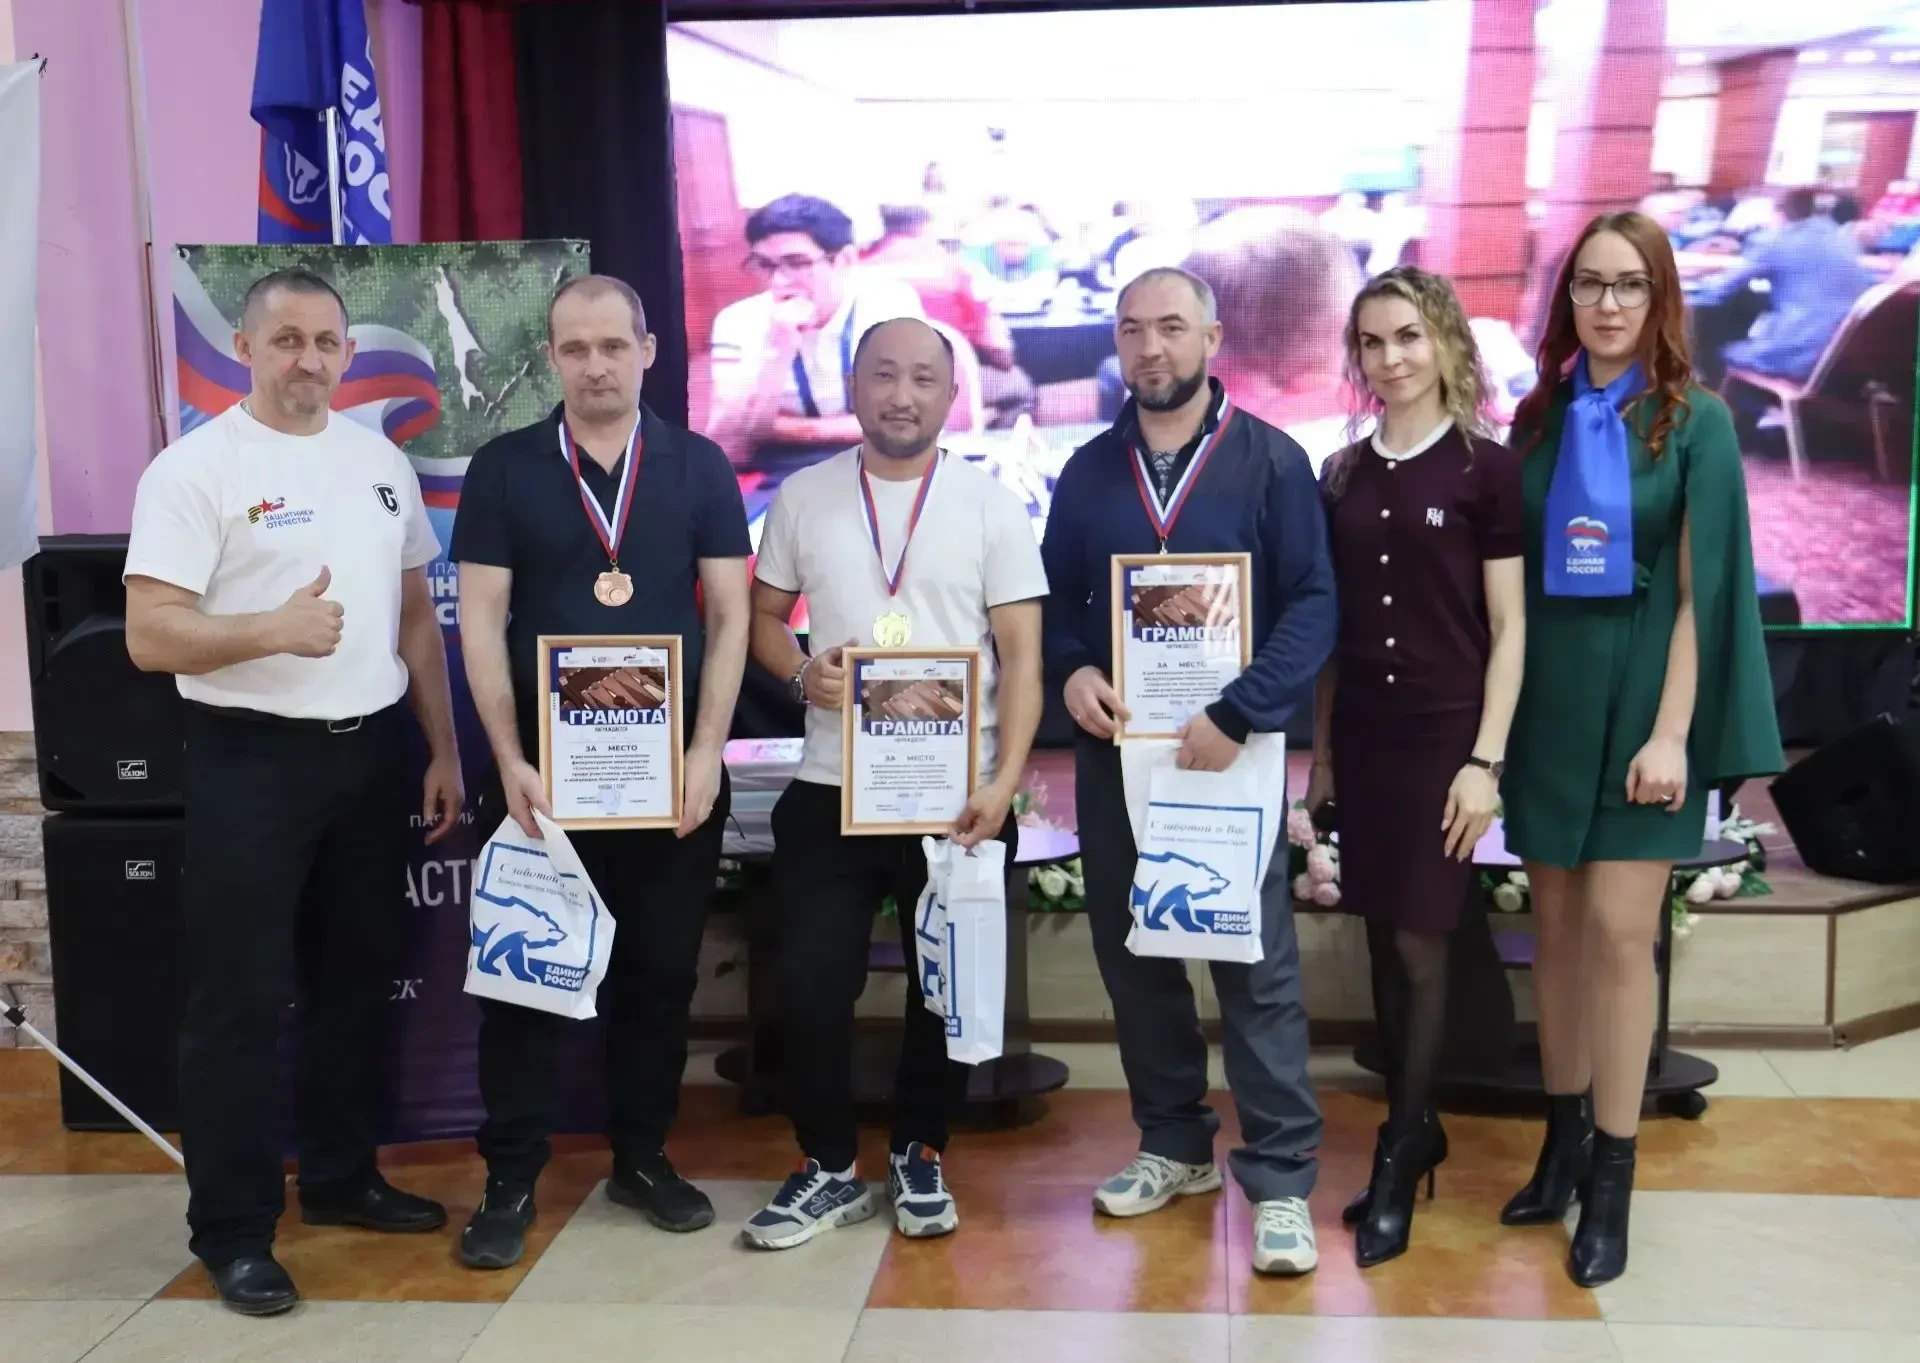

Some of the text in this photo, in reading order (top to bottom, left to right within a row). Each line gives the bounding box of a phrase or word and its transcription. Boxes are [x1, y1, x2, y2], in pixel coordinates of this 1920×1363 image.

[264, 509, 315, 522] ЗАЩИТНИКИ
[266, 517, 312, 529] ОТЕЧЕСТВА
[1566, 557, 1605, 566] ЕДИНАЯ
[1566, 565, 1605, 574] РОССИЯ
[569, 709, 665, 725] ГРАМОТА
[870, 720, 962, 735] ГРАМОТА
[608, 744, 638, 752] МЕСТО
